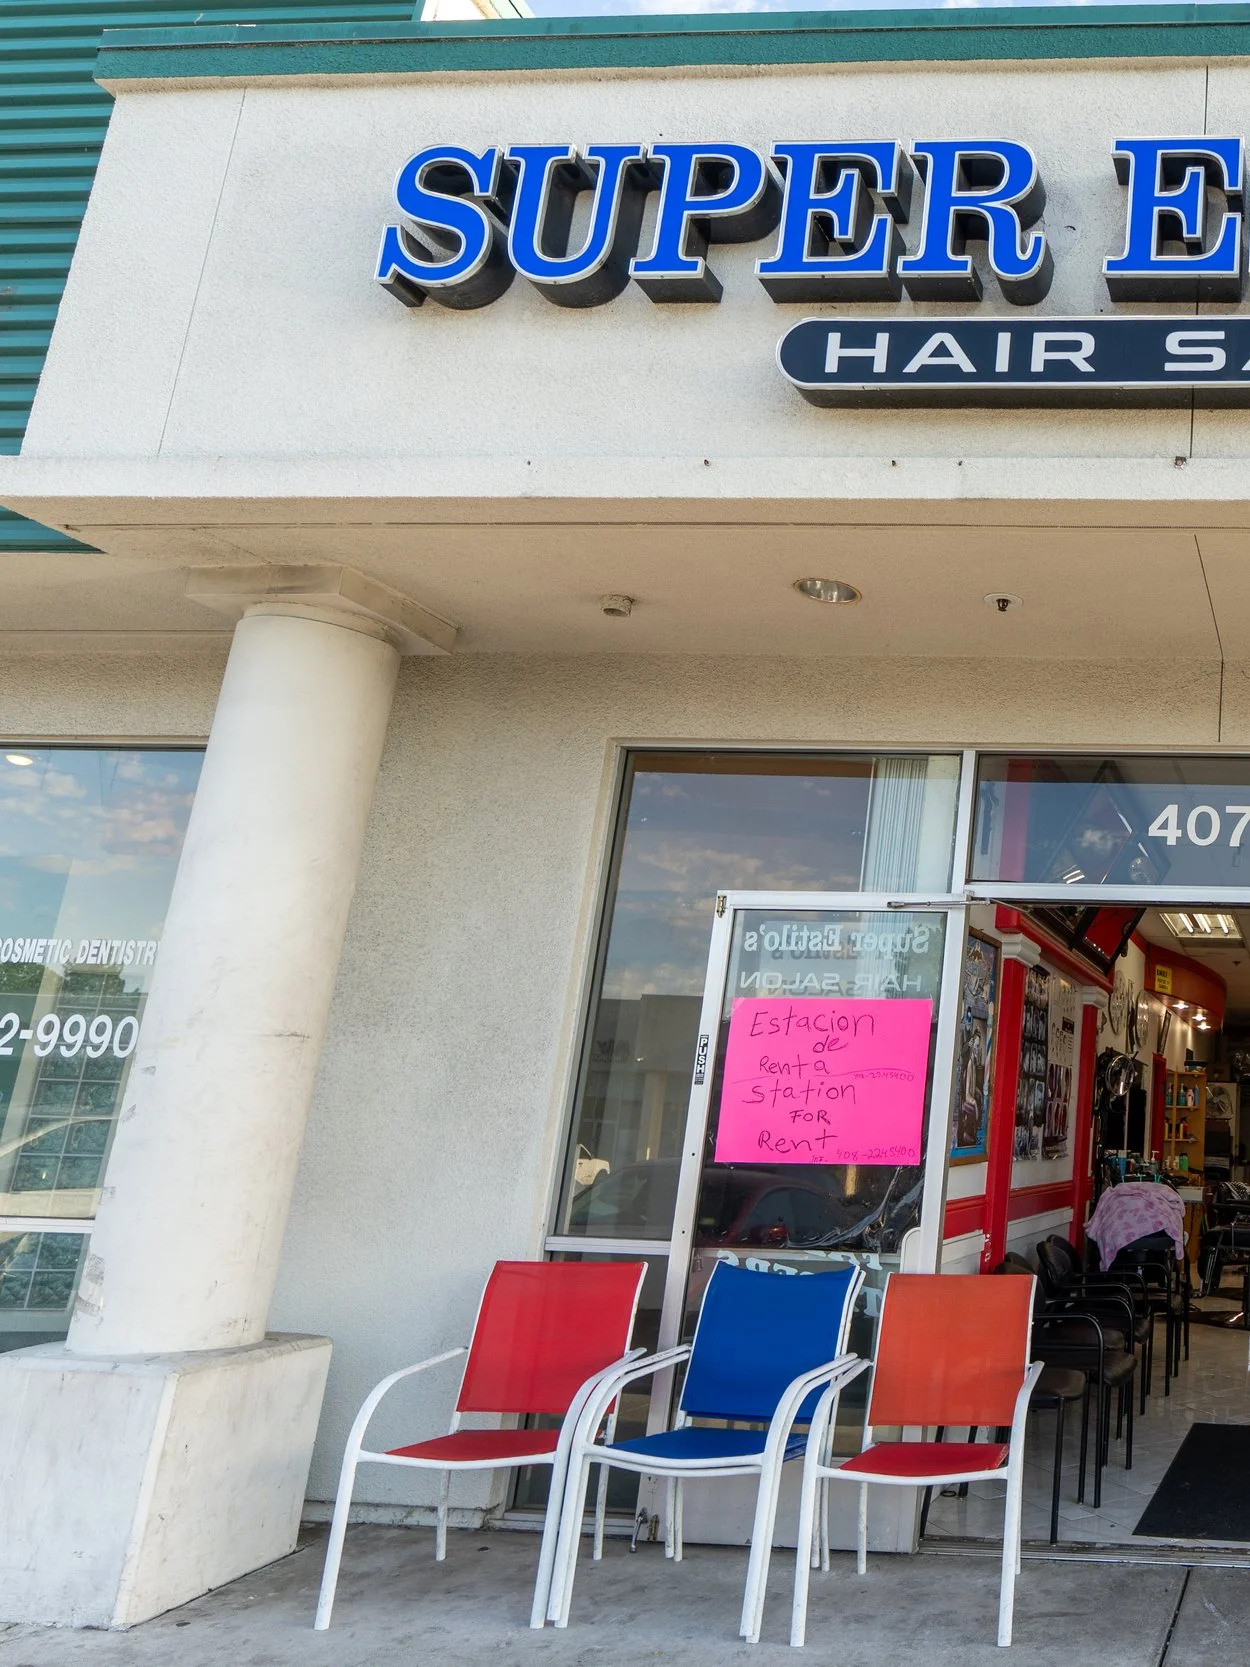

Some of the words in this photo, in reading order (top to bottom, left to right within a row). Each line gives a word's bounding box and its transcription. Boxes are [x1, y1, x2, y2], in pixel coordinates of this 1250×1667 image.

[374, 138, 1047, 287] SUPER
[824, 332, 1094, 374] HAIR
[0, 937, 73, 964] OSMETIC
[75, 939, 161, 966] DENTISTR
[750, 1006, 875, 1037] Estacion
[697, 1038, 708, 1073] PUSH
[812, 1034, 848, 1053] de
[757, 1128, 838, 1154] Rent
